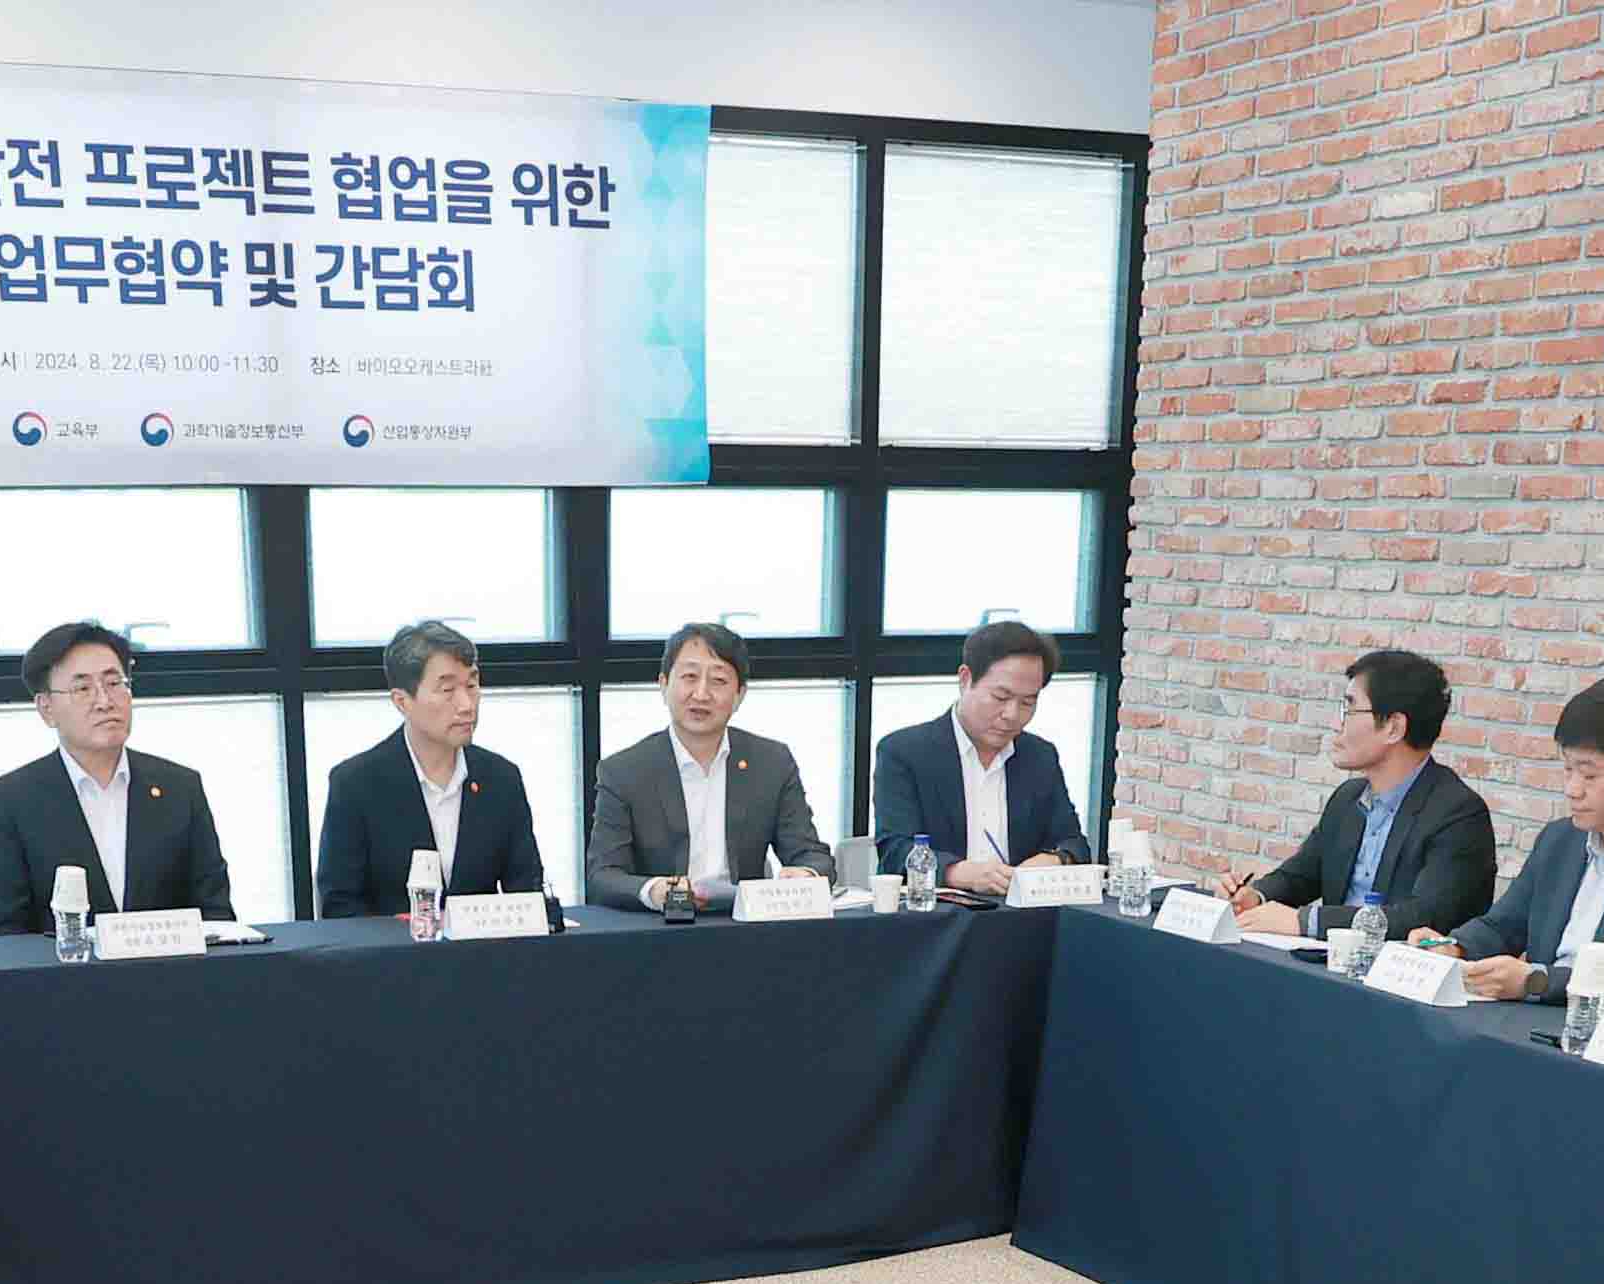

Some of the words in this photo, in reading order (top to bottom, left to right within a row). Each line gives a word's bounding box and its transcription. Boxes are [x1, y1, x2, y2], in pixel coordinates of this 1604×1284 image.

[84, 142, 316, 216] 프로젝트
[330, 151, 494, 225] 협업을
[510, 162, 617, 229] 위한
[246, 242, 298, 308] 및
[316, 244, 475, 312] 간담회
[310, 355, 341, 376] 장소
[56, 423, 100, 440] 교육부
[183, 423, 304, 441] 과학기술정보통신부
[382, 424, 472, 441] 산업통상자원부
